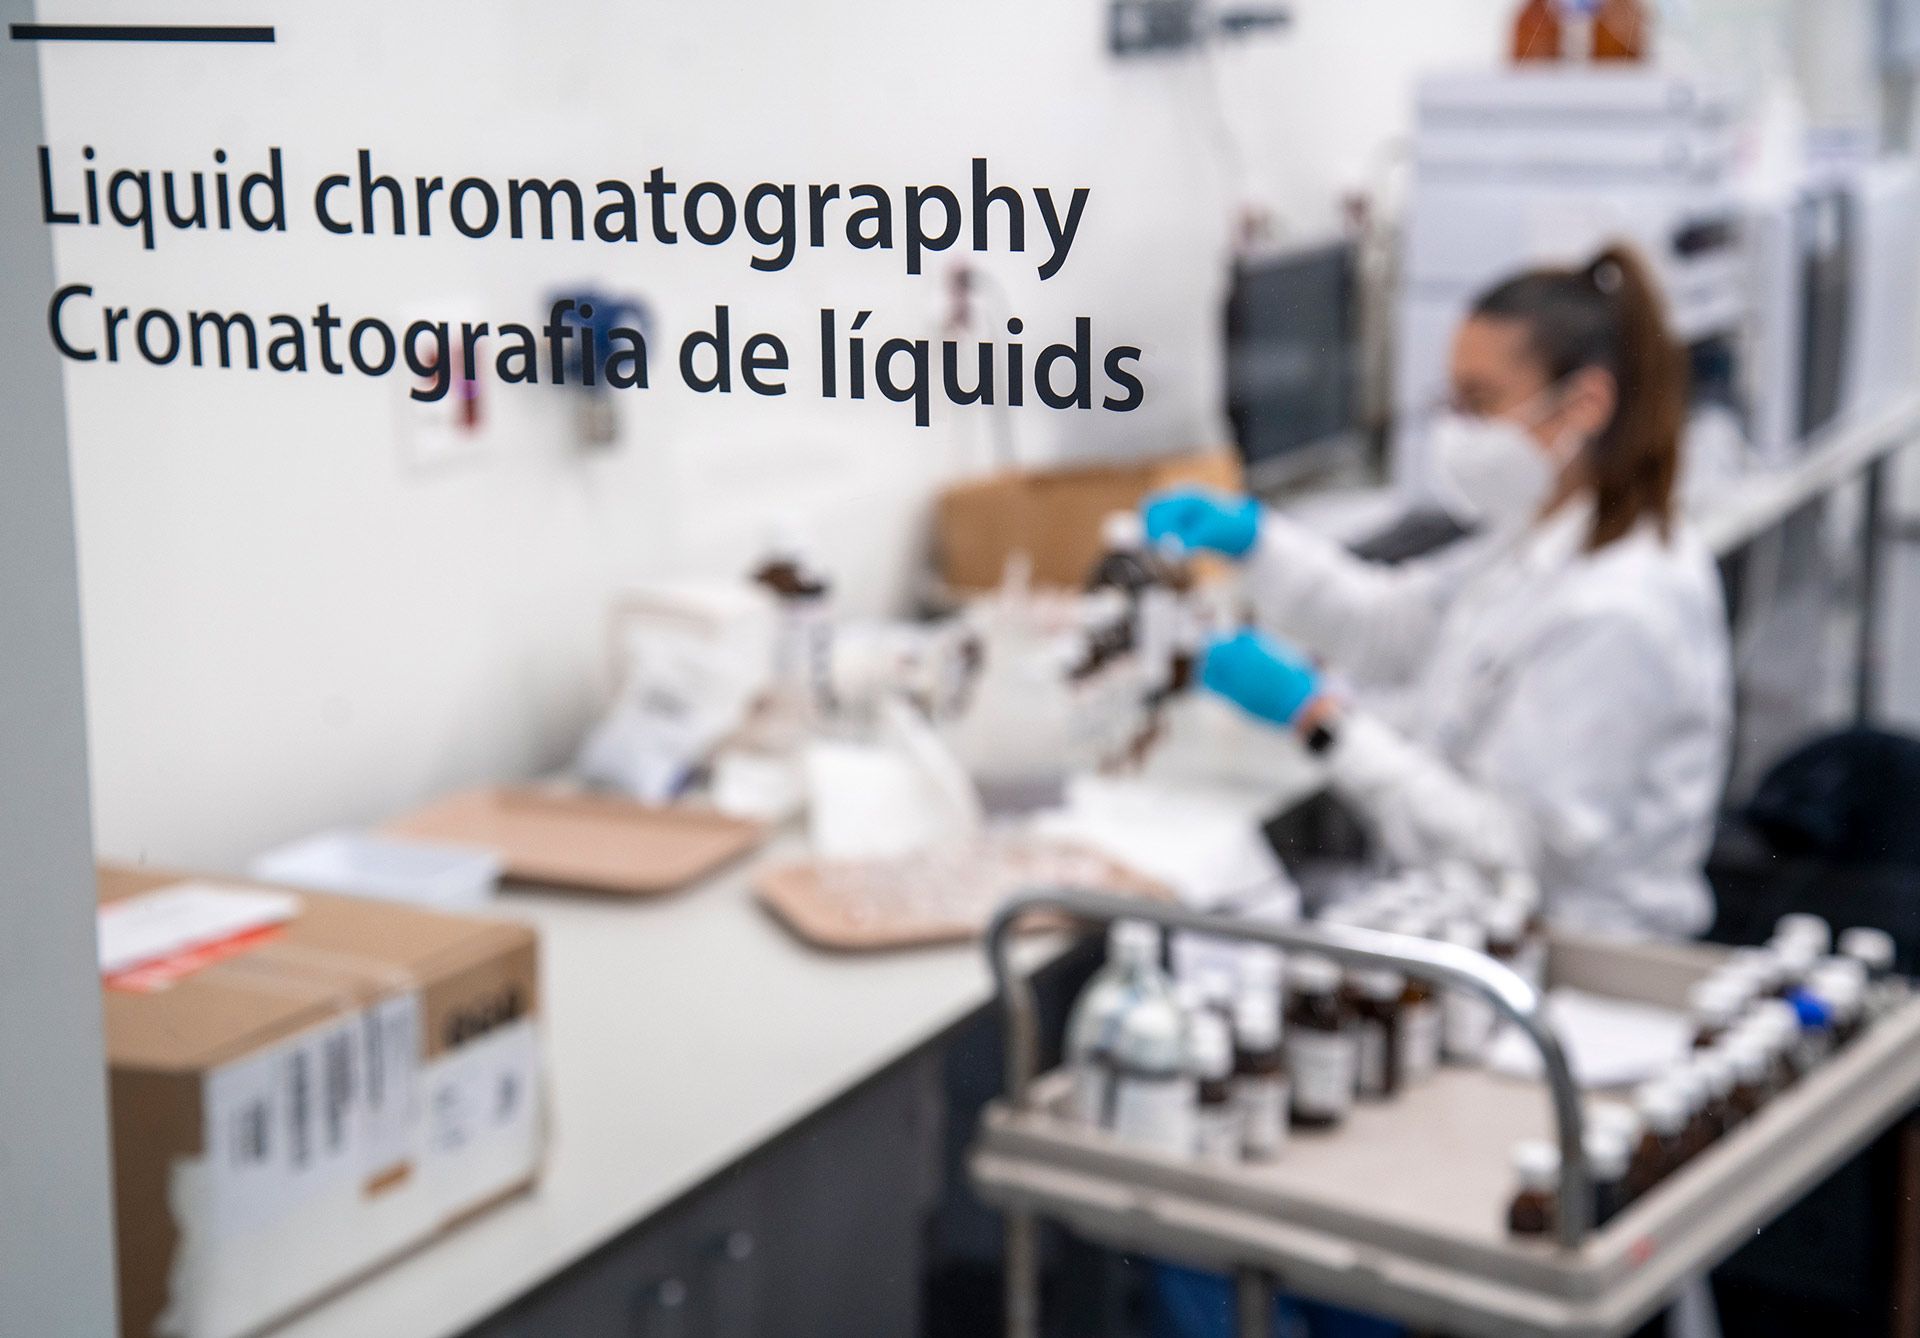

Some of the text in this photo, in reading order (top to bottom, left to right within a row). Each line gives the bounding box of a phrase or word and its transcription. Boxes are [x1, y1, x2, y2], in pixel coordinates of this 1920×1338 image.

[38, 146, 1091, 281] Liquid chromatography
[48, 284, 1145, 427] Cromatografia de líquids
